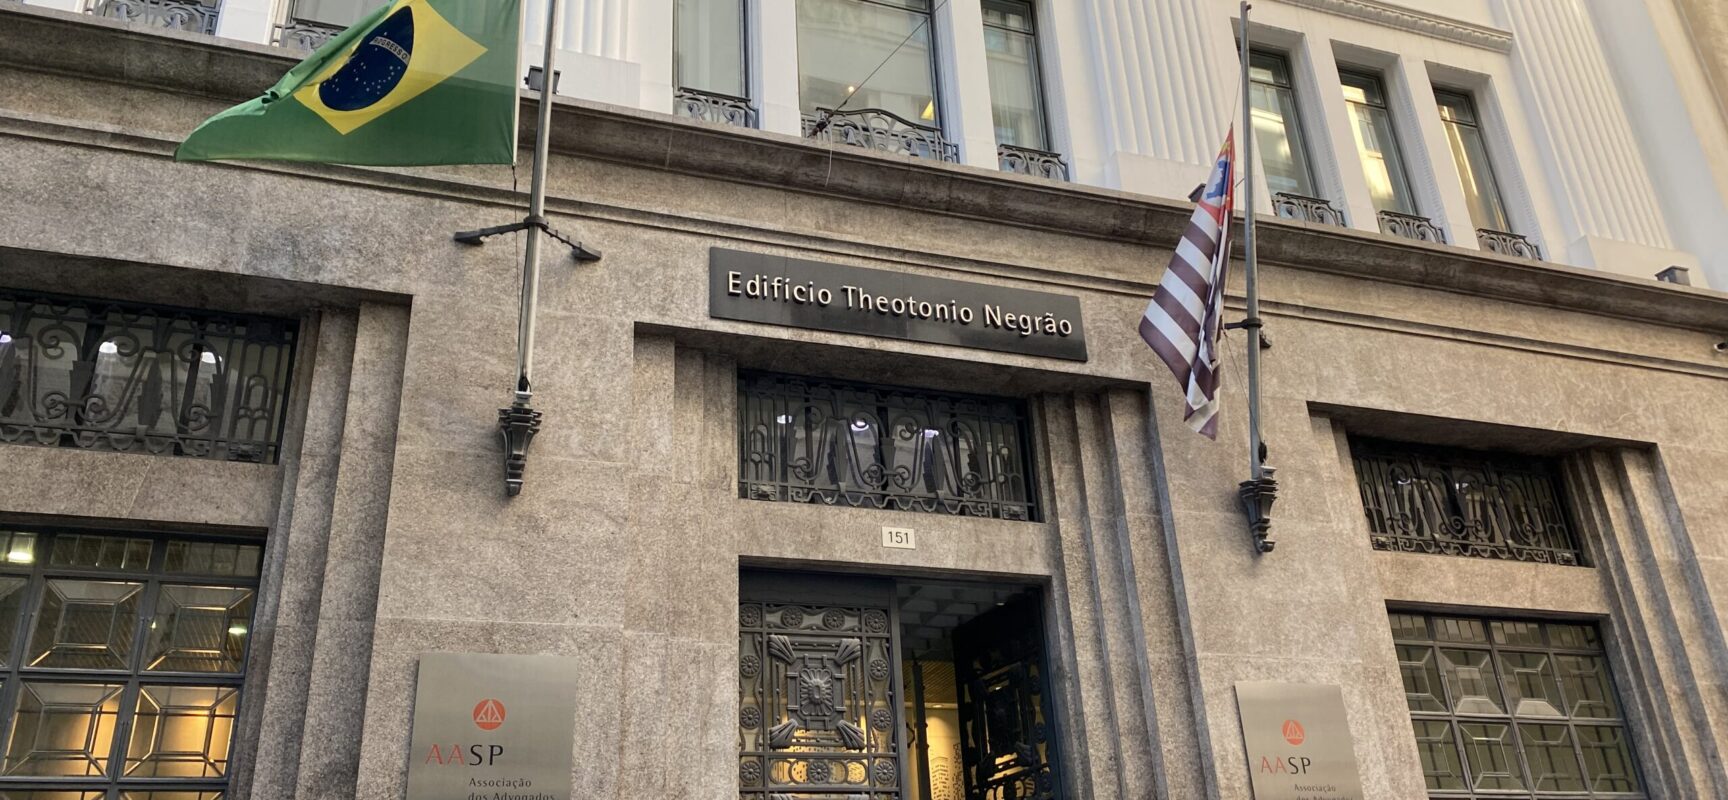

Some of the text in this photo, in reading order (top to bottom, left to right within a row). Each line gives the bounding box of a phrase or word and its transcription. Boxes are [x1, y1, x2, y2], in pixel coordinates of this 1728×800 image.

[373, 37, 408, 60] ROGRESSO
[727, 270, 1073, 337] Edifício Theotonio Negrão
[888, 531, 909, 545] 151
[425, 744, 504, 766] AASP
[1261, 756, 1311, 775] AASP
[468, 777, 532, 789] Associação
